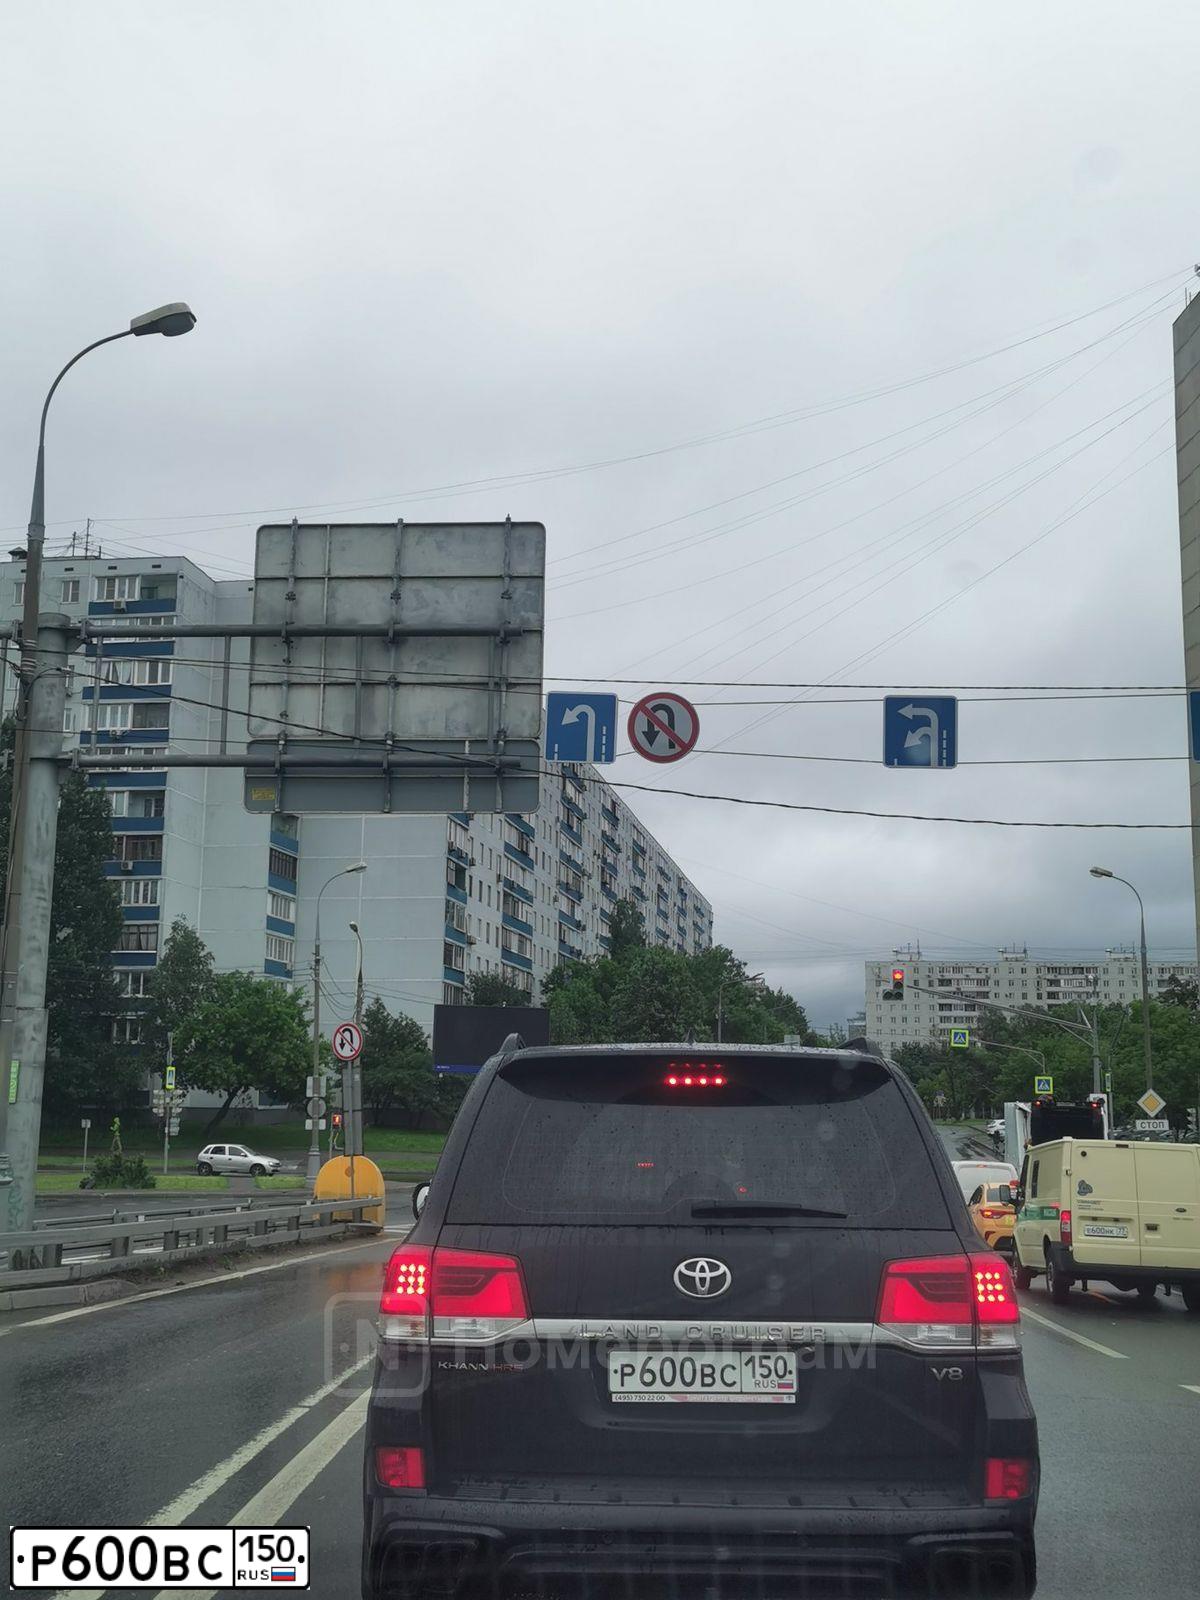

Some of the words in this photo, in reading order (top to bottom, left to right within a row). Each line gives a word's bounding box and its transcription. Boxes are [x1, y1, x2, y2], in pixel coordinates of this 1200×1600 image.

[1140, 1121, 1165, 1129] СТОП
[579, 1324, 662, 1339] LAND
[686, 1325, 827, 1341] CRUISER
[620, 1356, 737, 1387] Р600ВС
[744, 1355, 788, 1379] 150
[930, 1367, 963, 1380] V8
[754, 1379, 777, 1389] RUS
